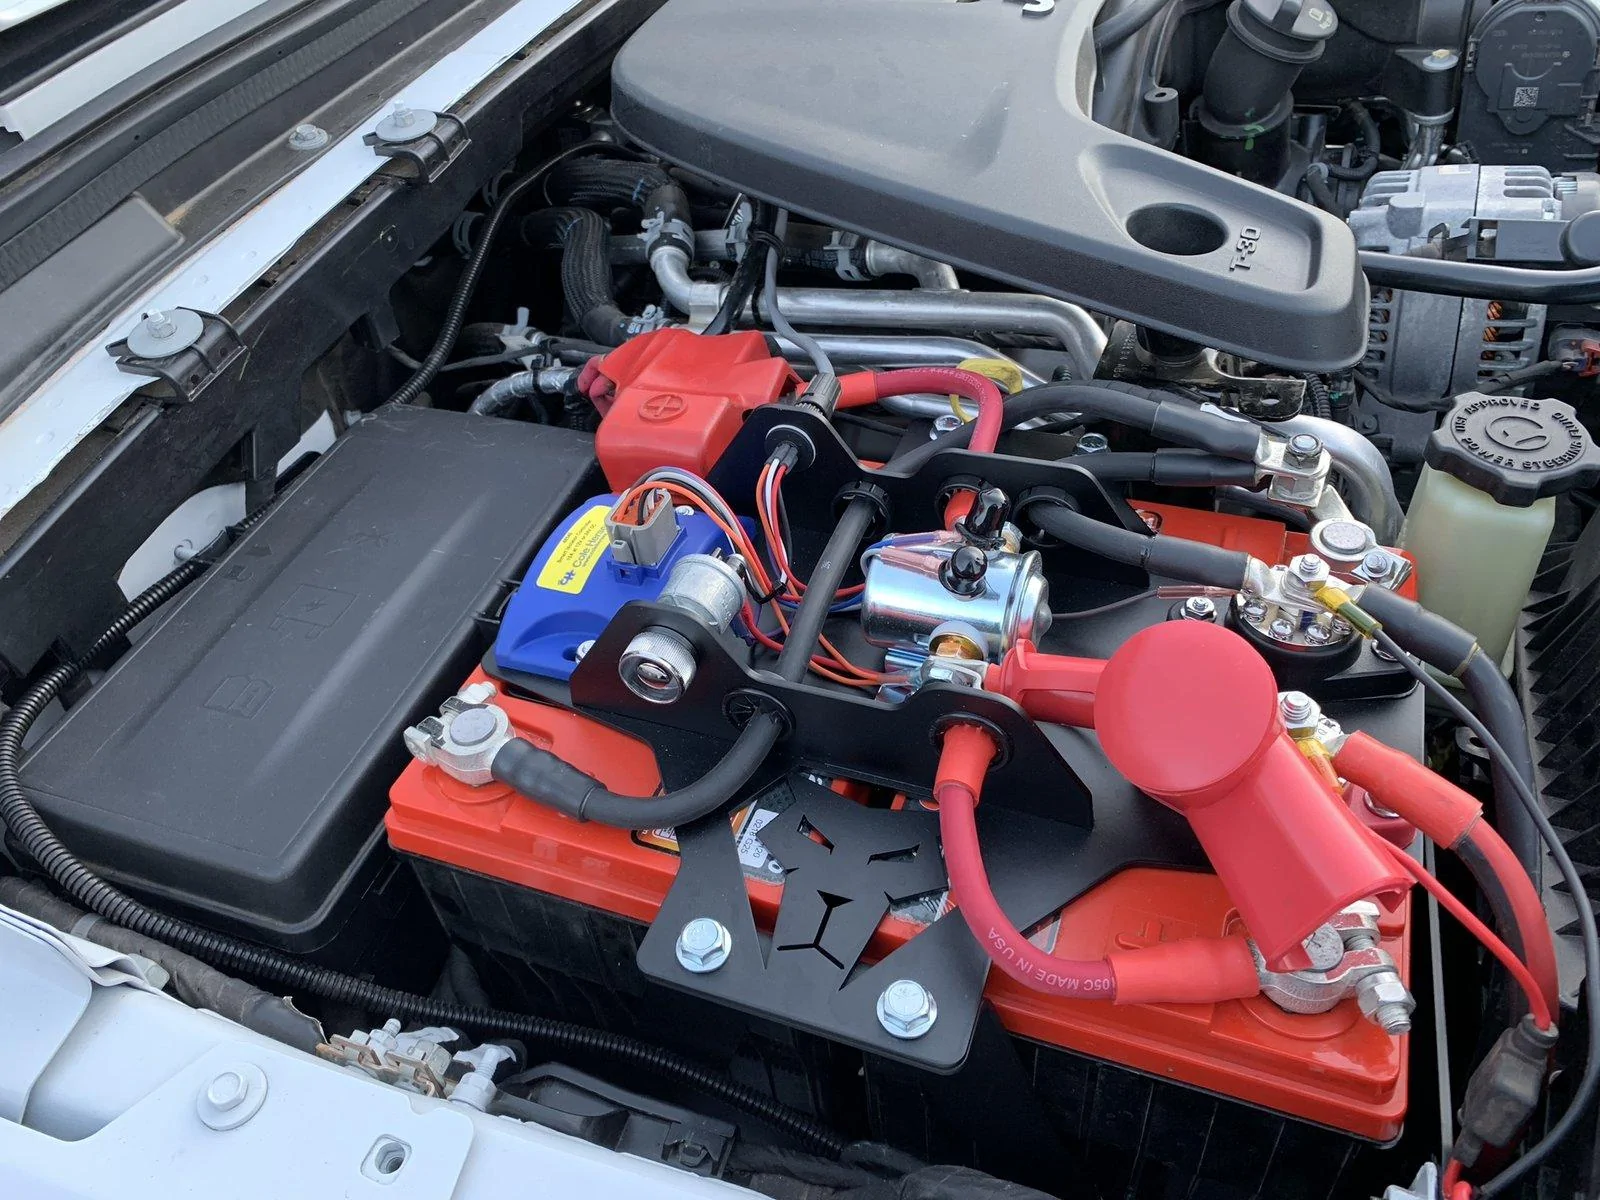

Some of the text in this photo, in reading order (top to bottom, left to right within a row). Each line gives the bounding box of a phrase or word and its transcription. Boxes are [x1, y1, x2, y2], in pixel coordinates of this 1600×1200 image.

[1230, 225, 1260, 271] T-30
[1464, 398, 1541, 414] APPROVED
[1462, 412, 1582, 469] POWER STEERING FLUID
[573, 547, 590, 567] Cole
[741, 838, 753, 854] G25
[988, 927, 1015, 959] USA
[1015, 957, 1034, 974] IN
[1035, 968, 1079, 990] MADE
